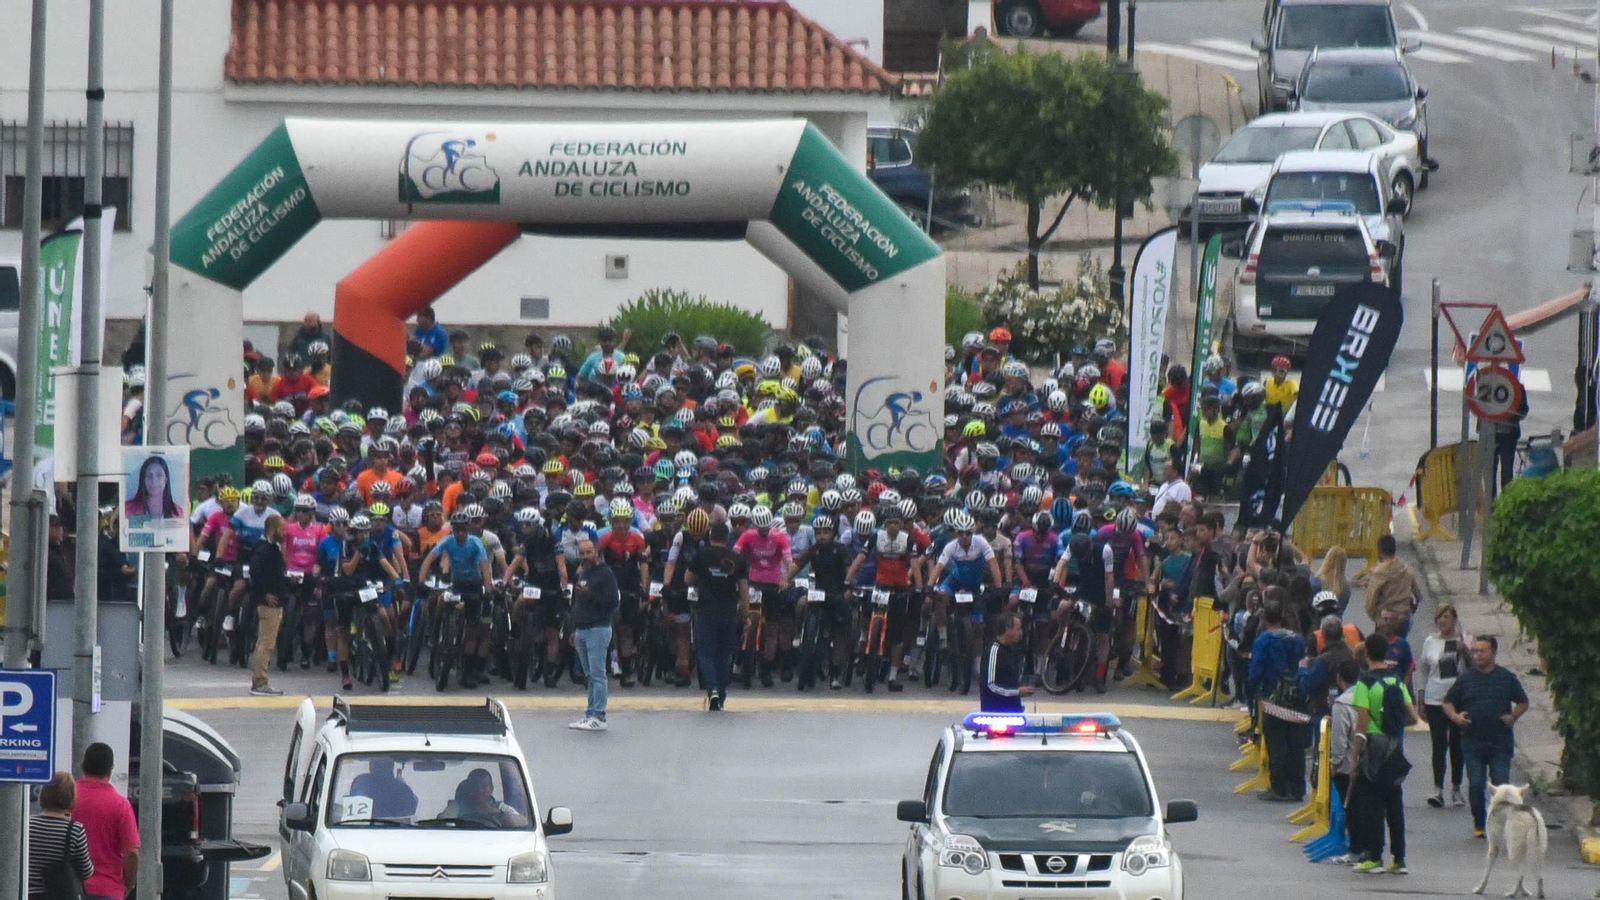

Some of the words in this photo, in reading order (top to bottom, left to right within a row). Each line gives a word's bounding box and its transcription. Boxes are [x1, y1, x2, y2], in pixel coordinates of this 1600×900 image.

[518, 160, 638, 177] ANDALUZA
[549, 138, 687, 156] FEDERACIÓN
[205, 165, 285, 241] FEDERACIÓN
[555, 181, 586, 197] DE
[588, 181, 690, 197] CICLISMO
[791, 180, 860, 244] ANDALUZA
[201, 203, 269, 268] ANDALUZA
[229, 238, 249, 261] DE
[247, 186, 307, 242] CICLISMO
[800, 207, 822, 228] DE
[818, 224, 879, 281] CICLISMO
[818, 181, 898, 258] FEDERACIÓN
[1479, 384, 1509, 403] 20
[0, 681, 34, 736] P
[346, 802, 368, 816] 12
